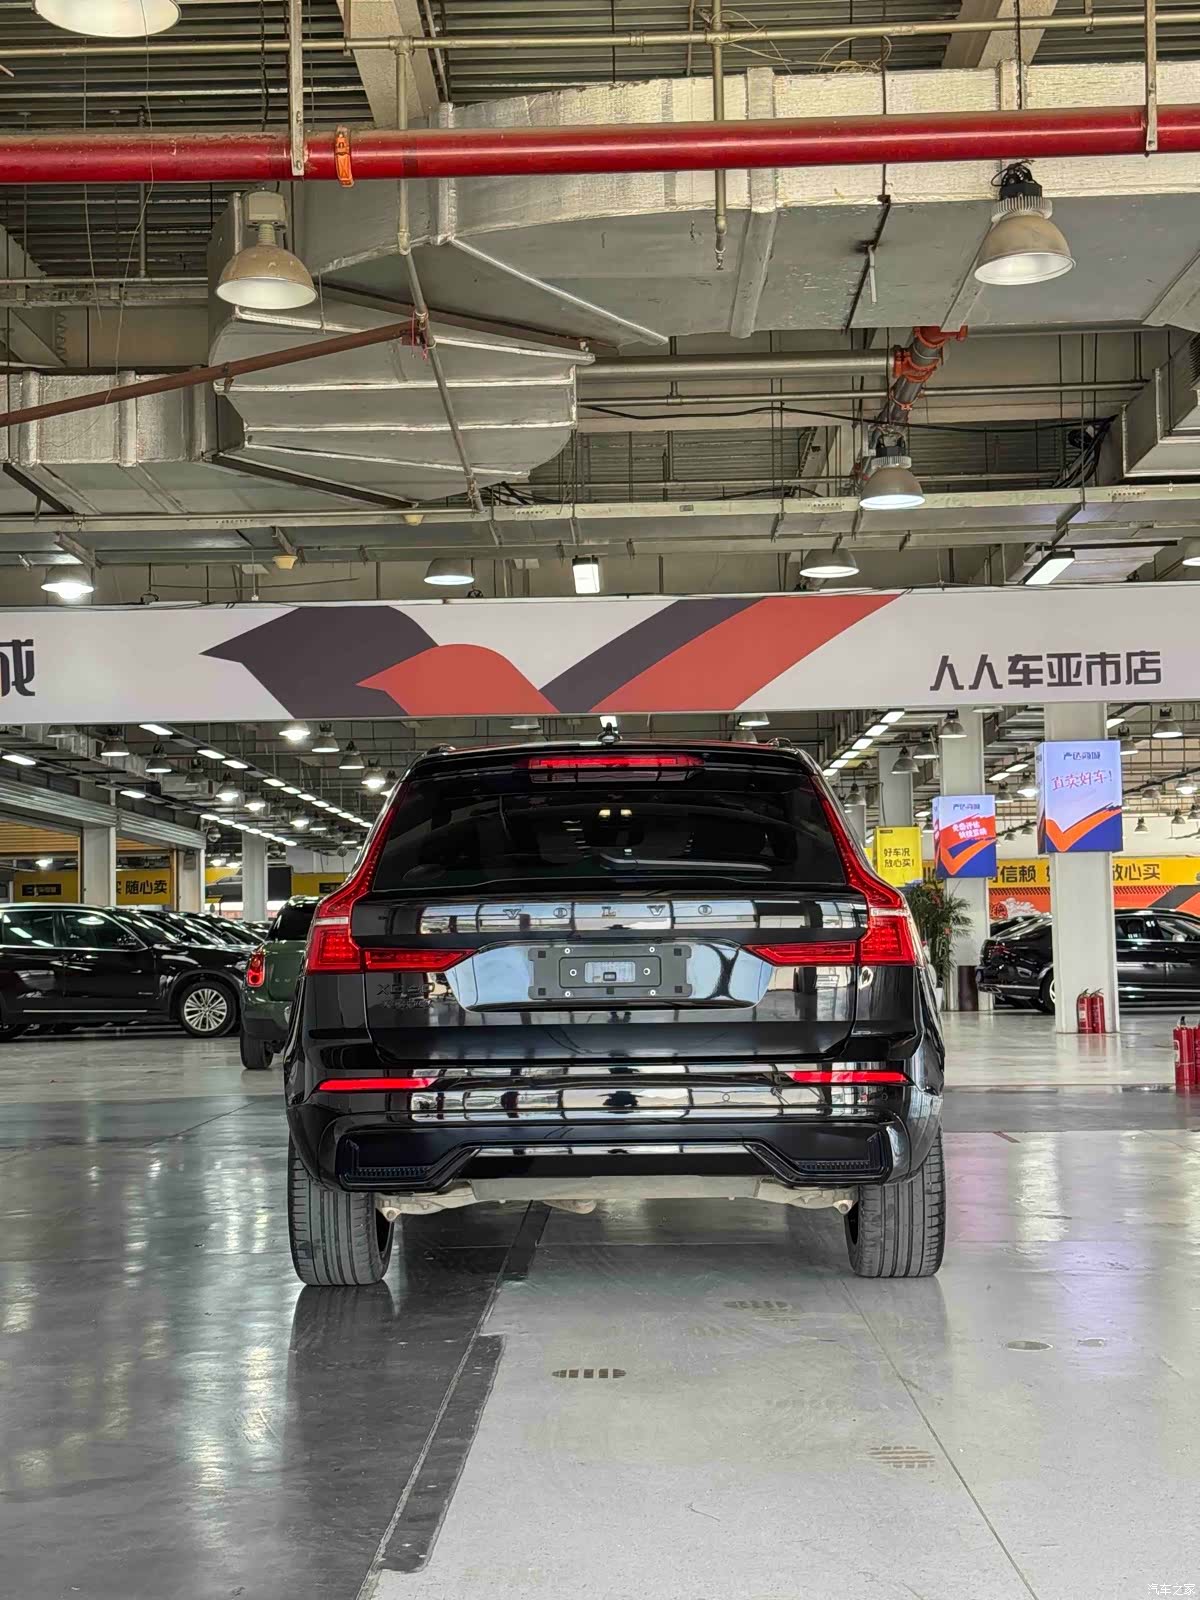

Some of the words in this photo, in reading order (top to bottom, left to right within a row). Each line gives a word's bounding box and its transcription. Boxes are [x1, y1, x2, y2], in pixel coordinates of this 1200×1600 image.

[930, 650, 1162, 691] 人人车亚市店
[884, 848, 910, 857] 好车况
[503, 904, 713, 920] VOLVO
